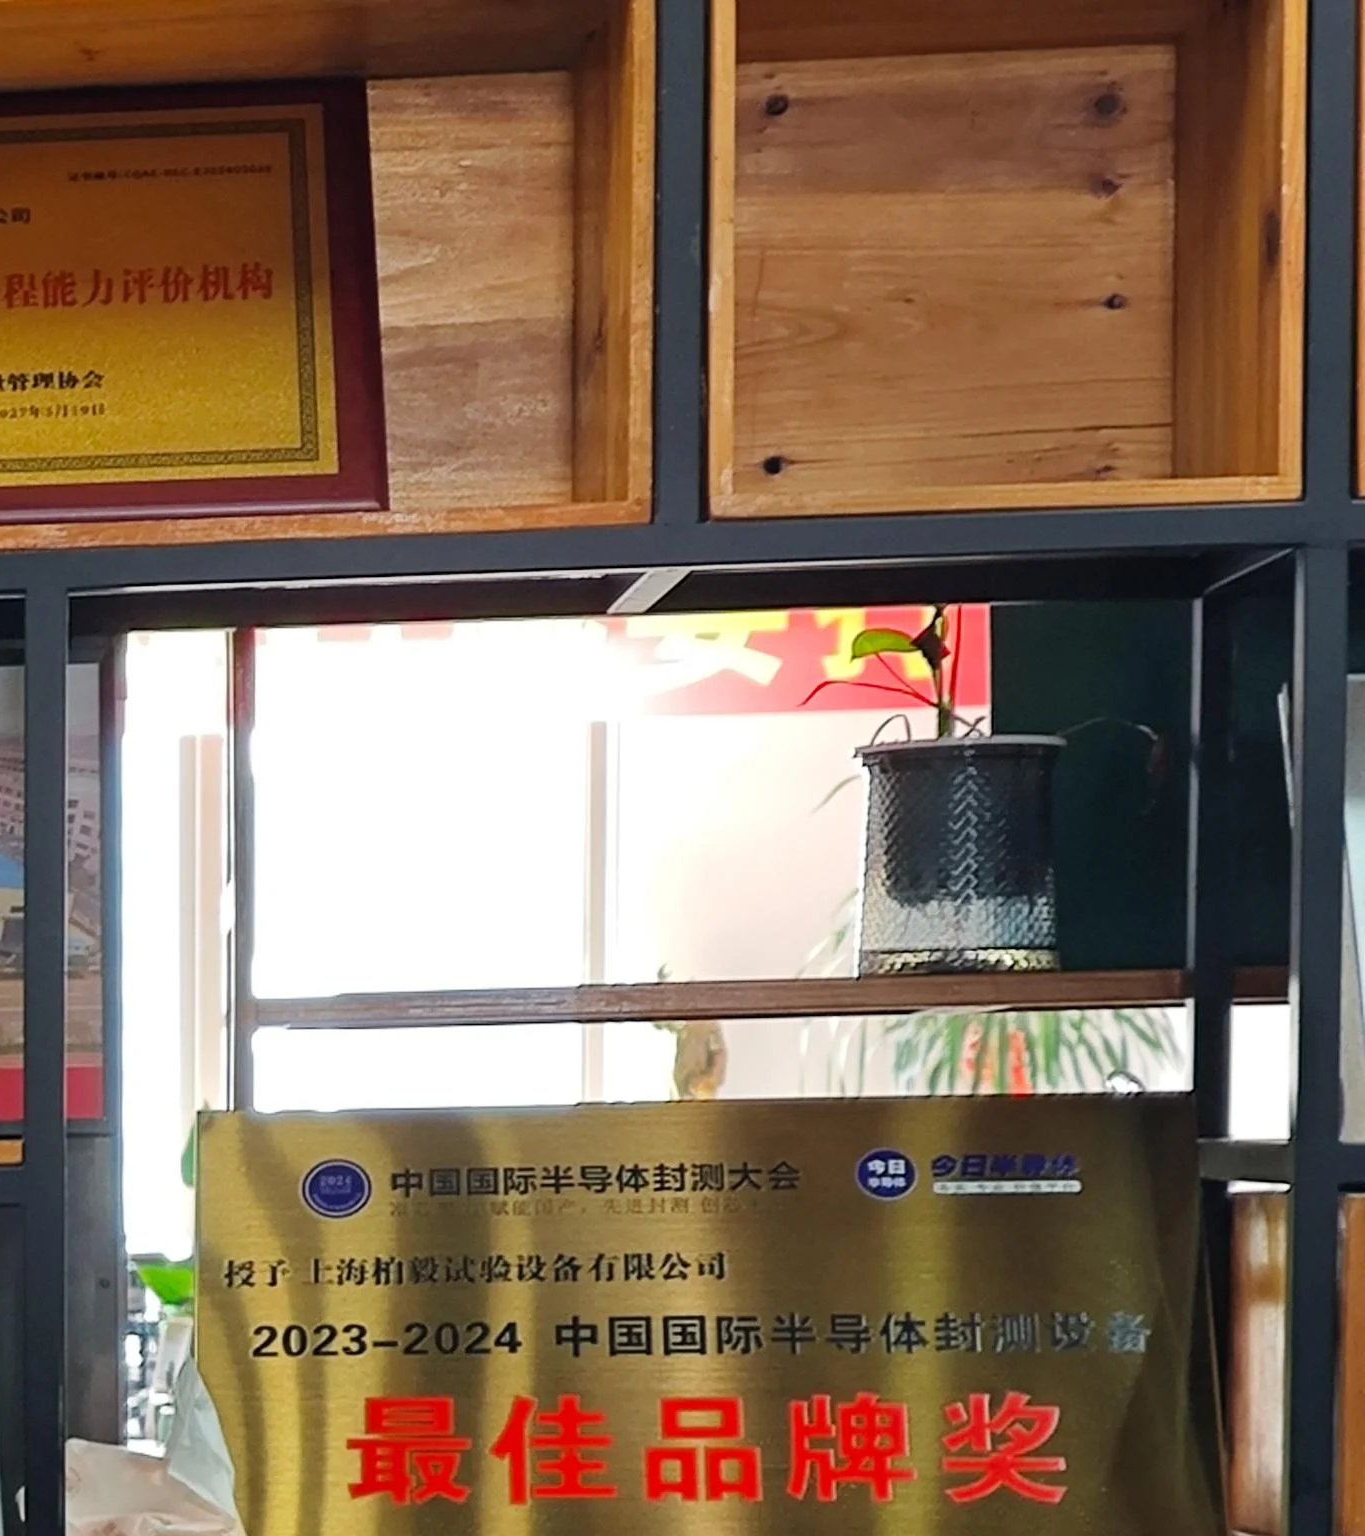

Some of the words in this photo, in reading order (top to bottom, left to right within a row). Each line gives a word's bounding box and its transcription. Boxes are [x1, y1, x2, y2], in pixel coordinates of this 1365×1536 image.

[389, 1162, 801, 1199] 中国国际半导体封测大会
[867, 1159, 907, 1175] 今日
[223, 1257, 291, 1290] 授予
[306, 1251, 727, 1287] 上海柏毅试验设备有限公司
[554, 1311, 1152, 1358] 中国国际半导体封测设备
[346, 1391, 1069, 1505] 最佳品牌奖
